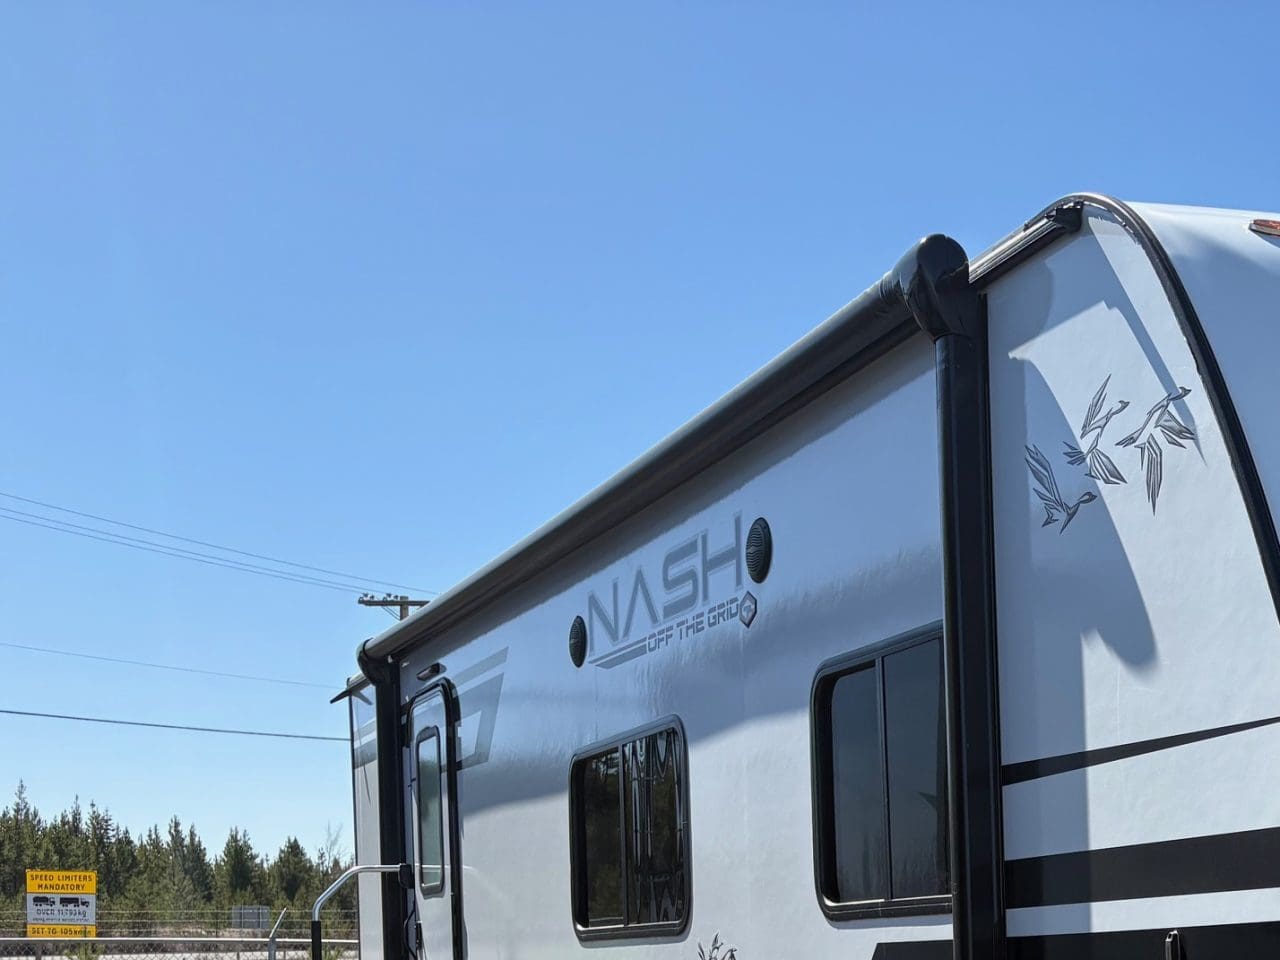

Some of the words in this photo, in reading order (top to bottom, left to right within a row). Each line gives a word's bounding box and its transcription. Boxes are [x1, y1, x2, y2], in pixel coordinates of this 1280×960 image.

[586, 511, 744, 657] NASH
[648, 625, 674, 653] OFF
[676, 611, 705, 641] THE
[707, 596, 739, 628] GRID
[37, 883, 86, 891] MANDATORY
[57, 874, 93, 882] LIMITERS
